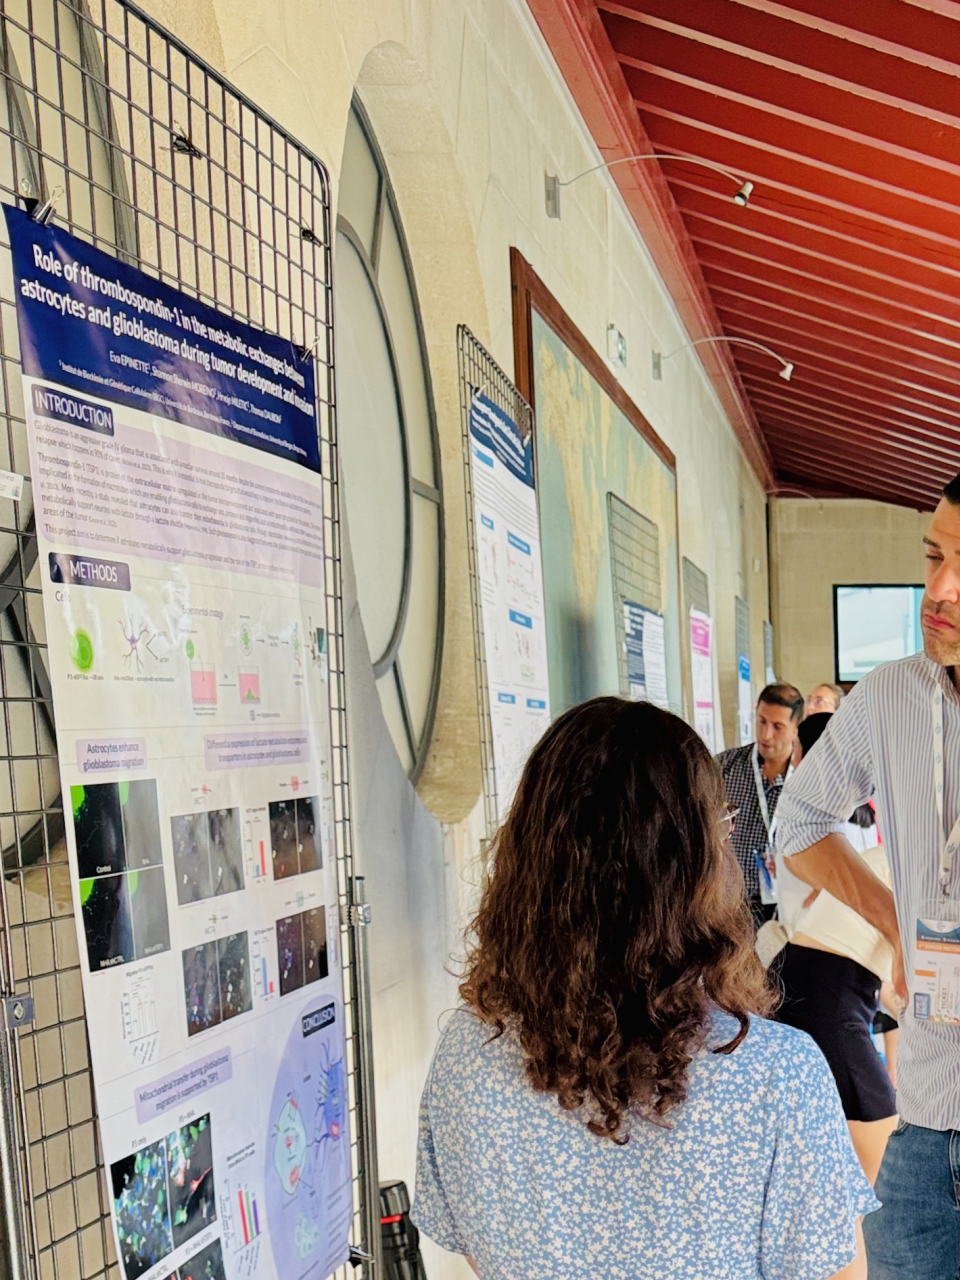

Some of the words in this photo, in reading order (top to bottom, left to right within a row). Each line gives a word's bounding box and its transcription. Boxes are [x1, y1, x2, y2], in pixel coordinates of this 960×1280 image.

[32, 244, 62, 277] Role
[64, 261, 78, 283] of
[80, 266, 181, 327] thrombospondin-1
[180, 309, 192, 332] in
[192, 316, 208, 338] the
[208, 326, 248, 358] metabolic
[248, 346, 284, 376] exchanges
[20, 279, 86, 319] astrocytes
[88, 306, 111, 328] and
[113, 310, 180, 355] glioblastoma
[180, 338, 210, 372] during
[210, 351, 236, 378] tumor
[238, 363, 282, 400] development
[34, 390, 112, 429] INTRODUCTION
[70, 560, 118, 582] METHODS
[87, 743, 118, 754] Astrocytes
